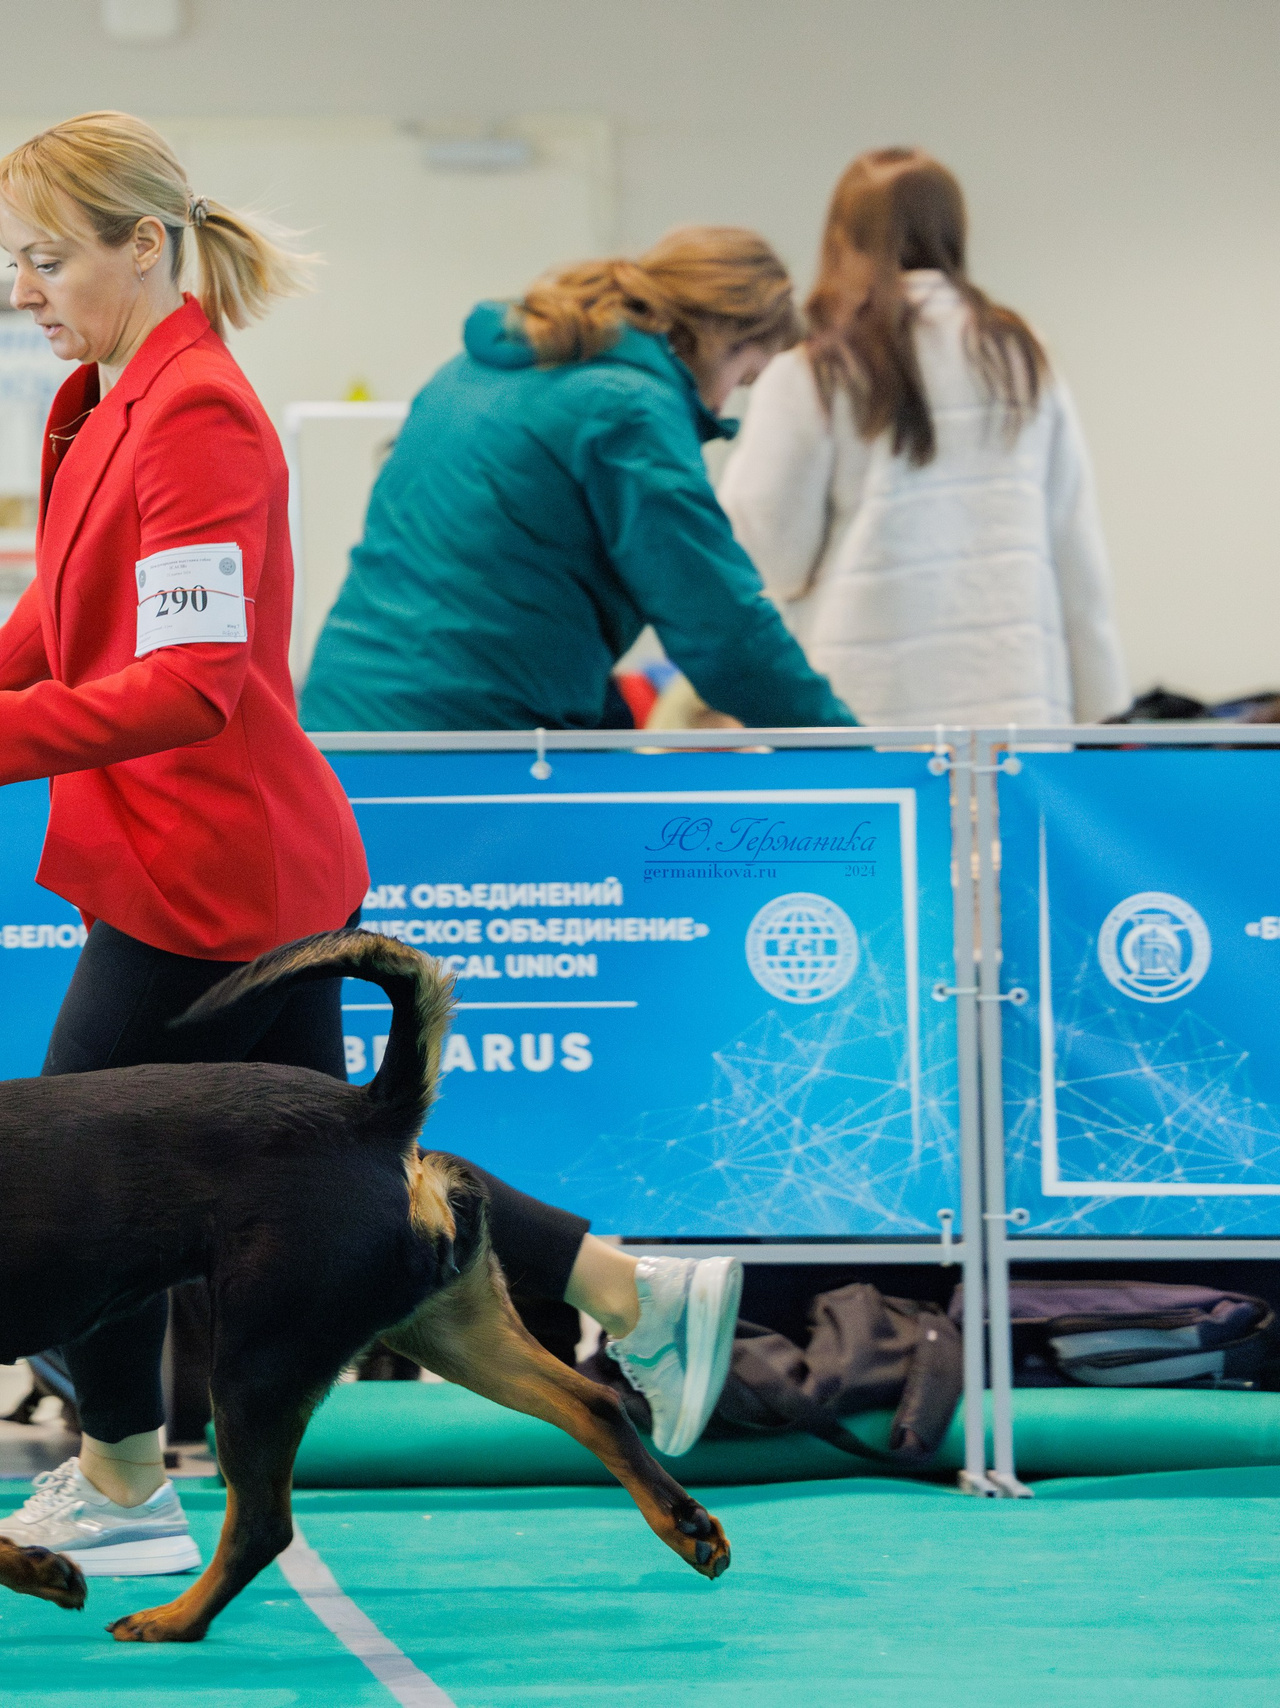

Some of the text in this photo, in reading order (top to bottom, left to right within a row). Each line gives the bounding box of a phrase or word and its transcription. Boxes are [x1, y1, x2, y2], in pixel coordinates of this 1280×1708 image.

[154, 584, 209, 618] 290
[410, 875, 624, 912] ОБЪЕДИНЕНИЙ
[485, 916, 710, 947] ОБЪЕДИНЕНИЕ»
[504, 952, 599, 979] UNION
[343, 1032, 594, 1074] BARUS
